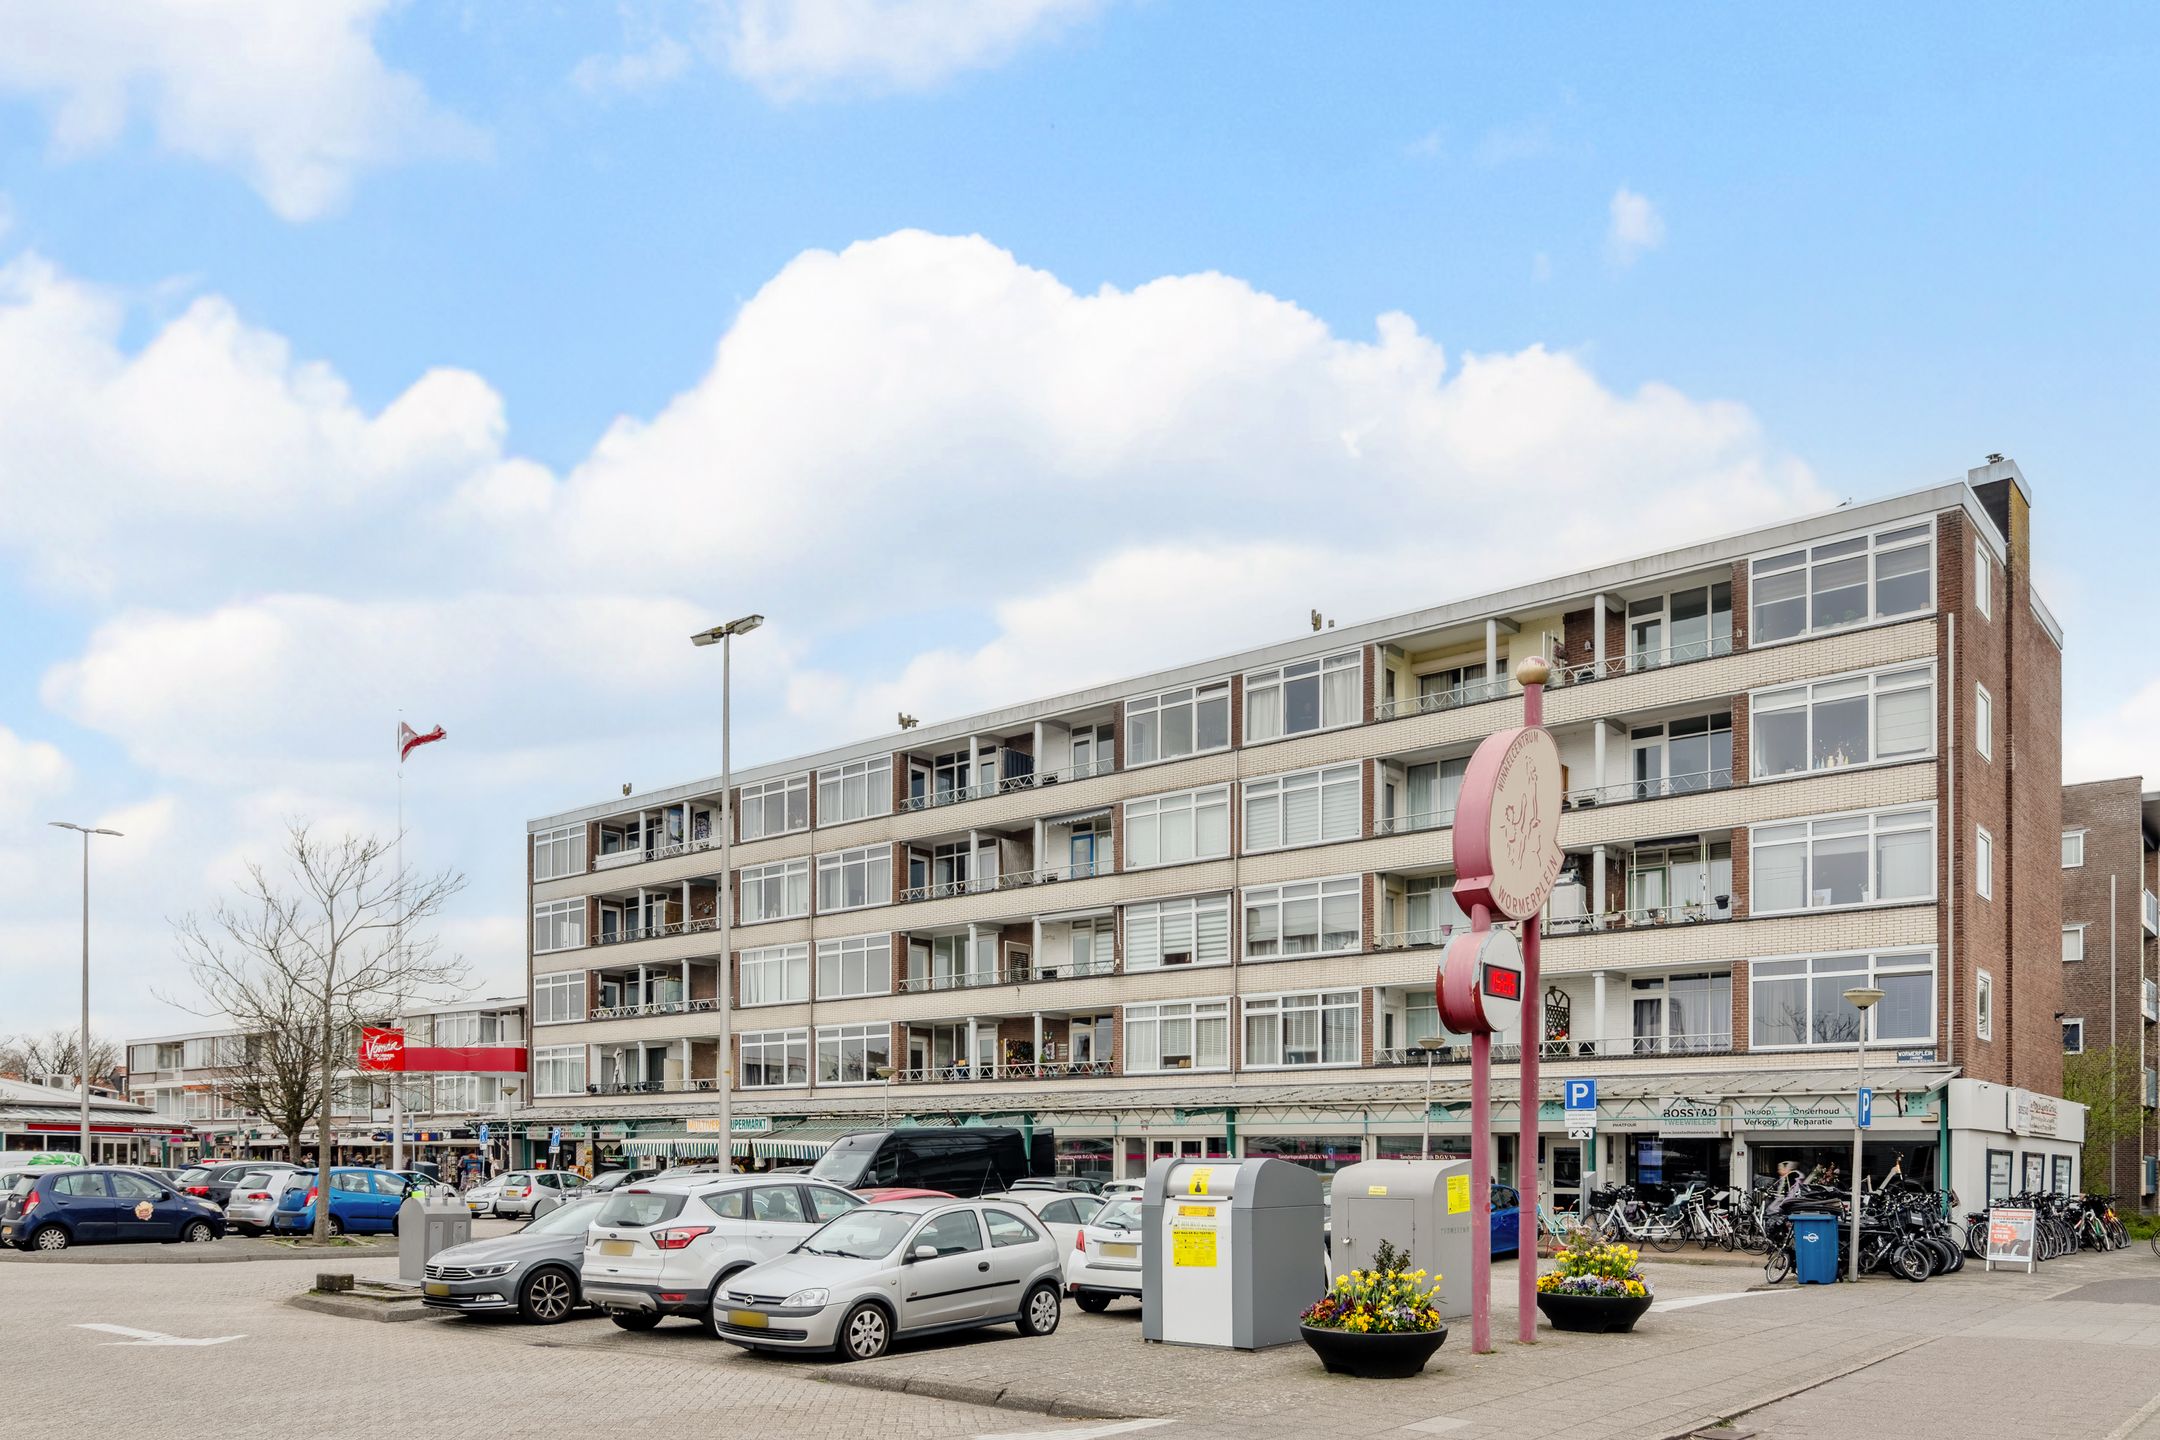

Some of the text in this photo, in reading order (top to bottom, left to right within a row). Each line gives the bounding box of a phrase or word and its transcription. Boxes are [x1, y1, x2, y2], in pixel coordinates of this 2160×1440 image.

[1497, 731, 1539, 792] WINKELCENTRUM
[1498, 855, 1558, 914] WORMERPLEIN
[1572, 1083, 1589, 1107] P
[1792, 1107, 1840, 1116] Onderhoud
[1862, 1092, 1870, 1122] P
[1663, 1108, 1717, 1118] BOSSTAD
[730, 1119, 767, 1130] UPERMARKT
[1664, 1117, 1717, 1126] TWEEWIELERS
[1793, 1118, 1833, 1126] Reparatie
